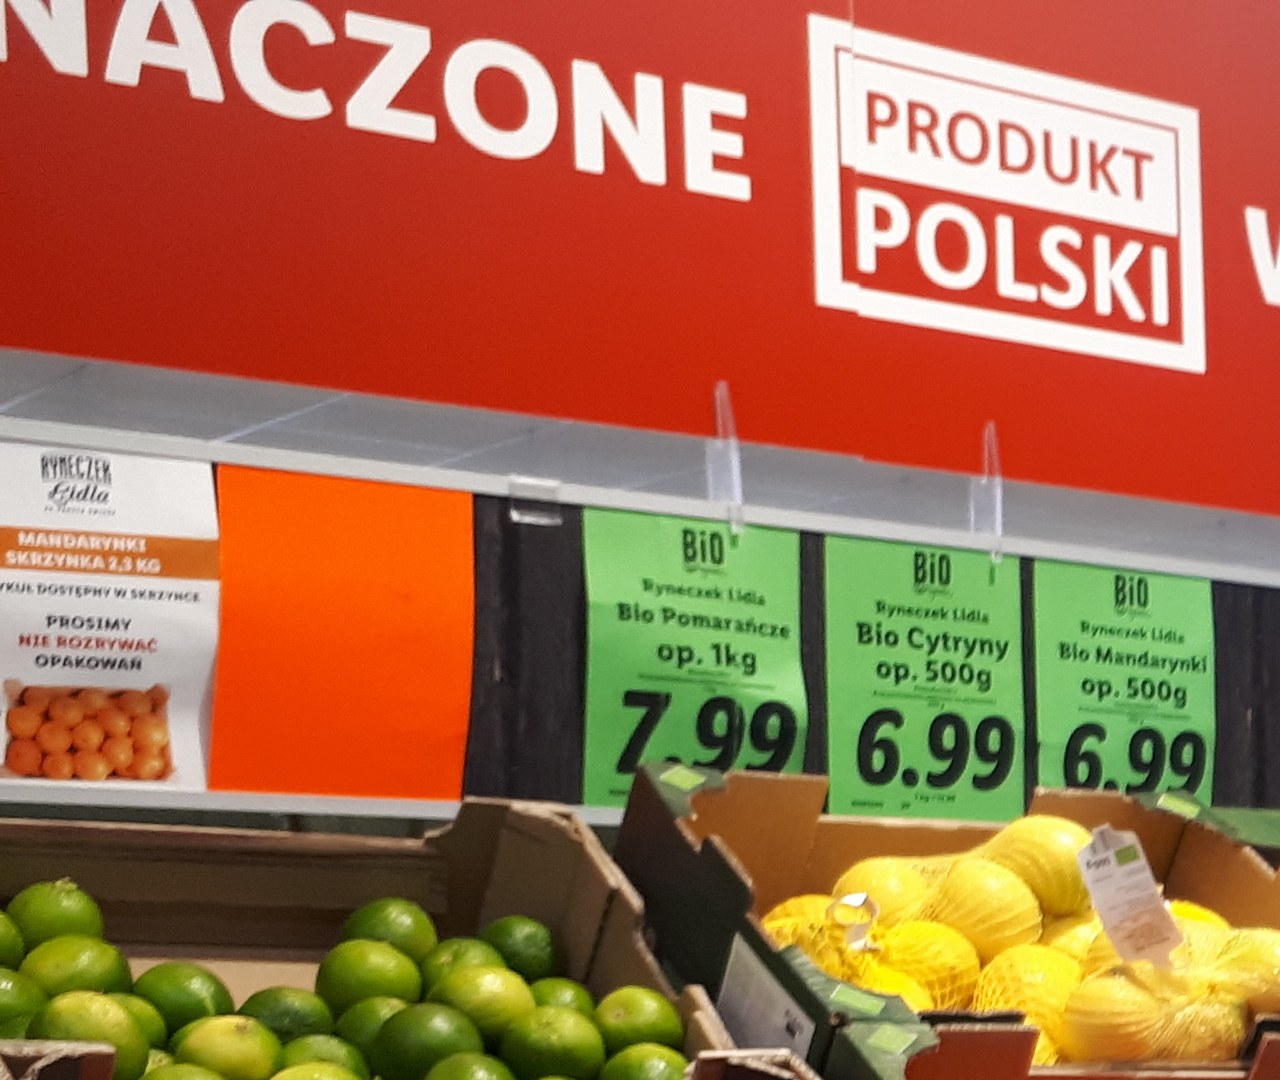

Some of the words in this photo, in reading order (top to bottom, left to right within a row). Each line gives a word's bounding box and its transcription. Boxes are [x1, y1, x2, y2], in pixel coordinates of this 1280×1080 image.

[866, 90, 1154, 202] PRODUKT
[855, 187, 1170, 327] POLSKI
[18, 531, 147, 553] MANDARYNKI
[682, 527, 725, 565] BiO
[5, 549, 105, 570] SKRZYNKA
[136, 558, 161, 574] KG
[913, 550, 952, 586] BiO
[1114, 573, 1149, 608] BiO
[46, 614, 132, 632] PROSIMY
[617, 601, 654, 624] Bio
[661, 606, 790, 640] Pomarańcze
[18, 632, 49, 649] NIE
[856, 621, 899, 648] Bio
[907, 626, 1010, 662] Cytryny
[1058, 640, 1090, 662] Bio
[1095, 644, 1208, 674] Mandarynki
[656, 642, 703, 669] op.
[710, 642, 757, 676] 1kg
[875, 660, 918, 686] op.
[924, 659, 992, 693] 500g
[1081, 676, 1120, 702] op.
[1126, 676, 1188, 709] 500g
[856, 707, 1015, 790] 6.99
[1063, 722, 1207, 795] 6.99
